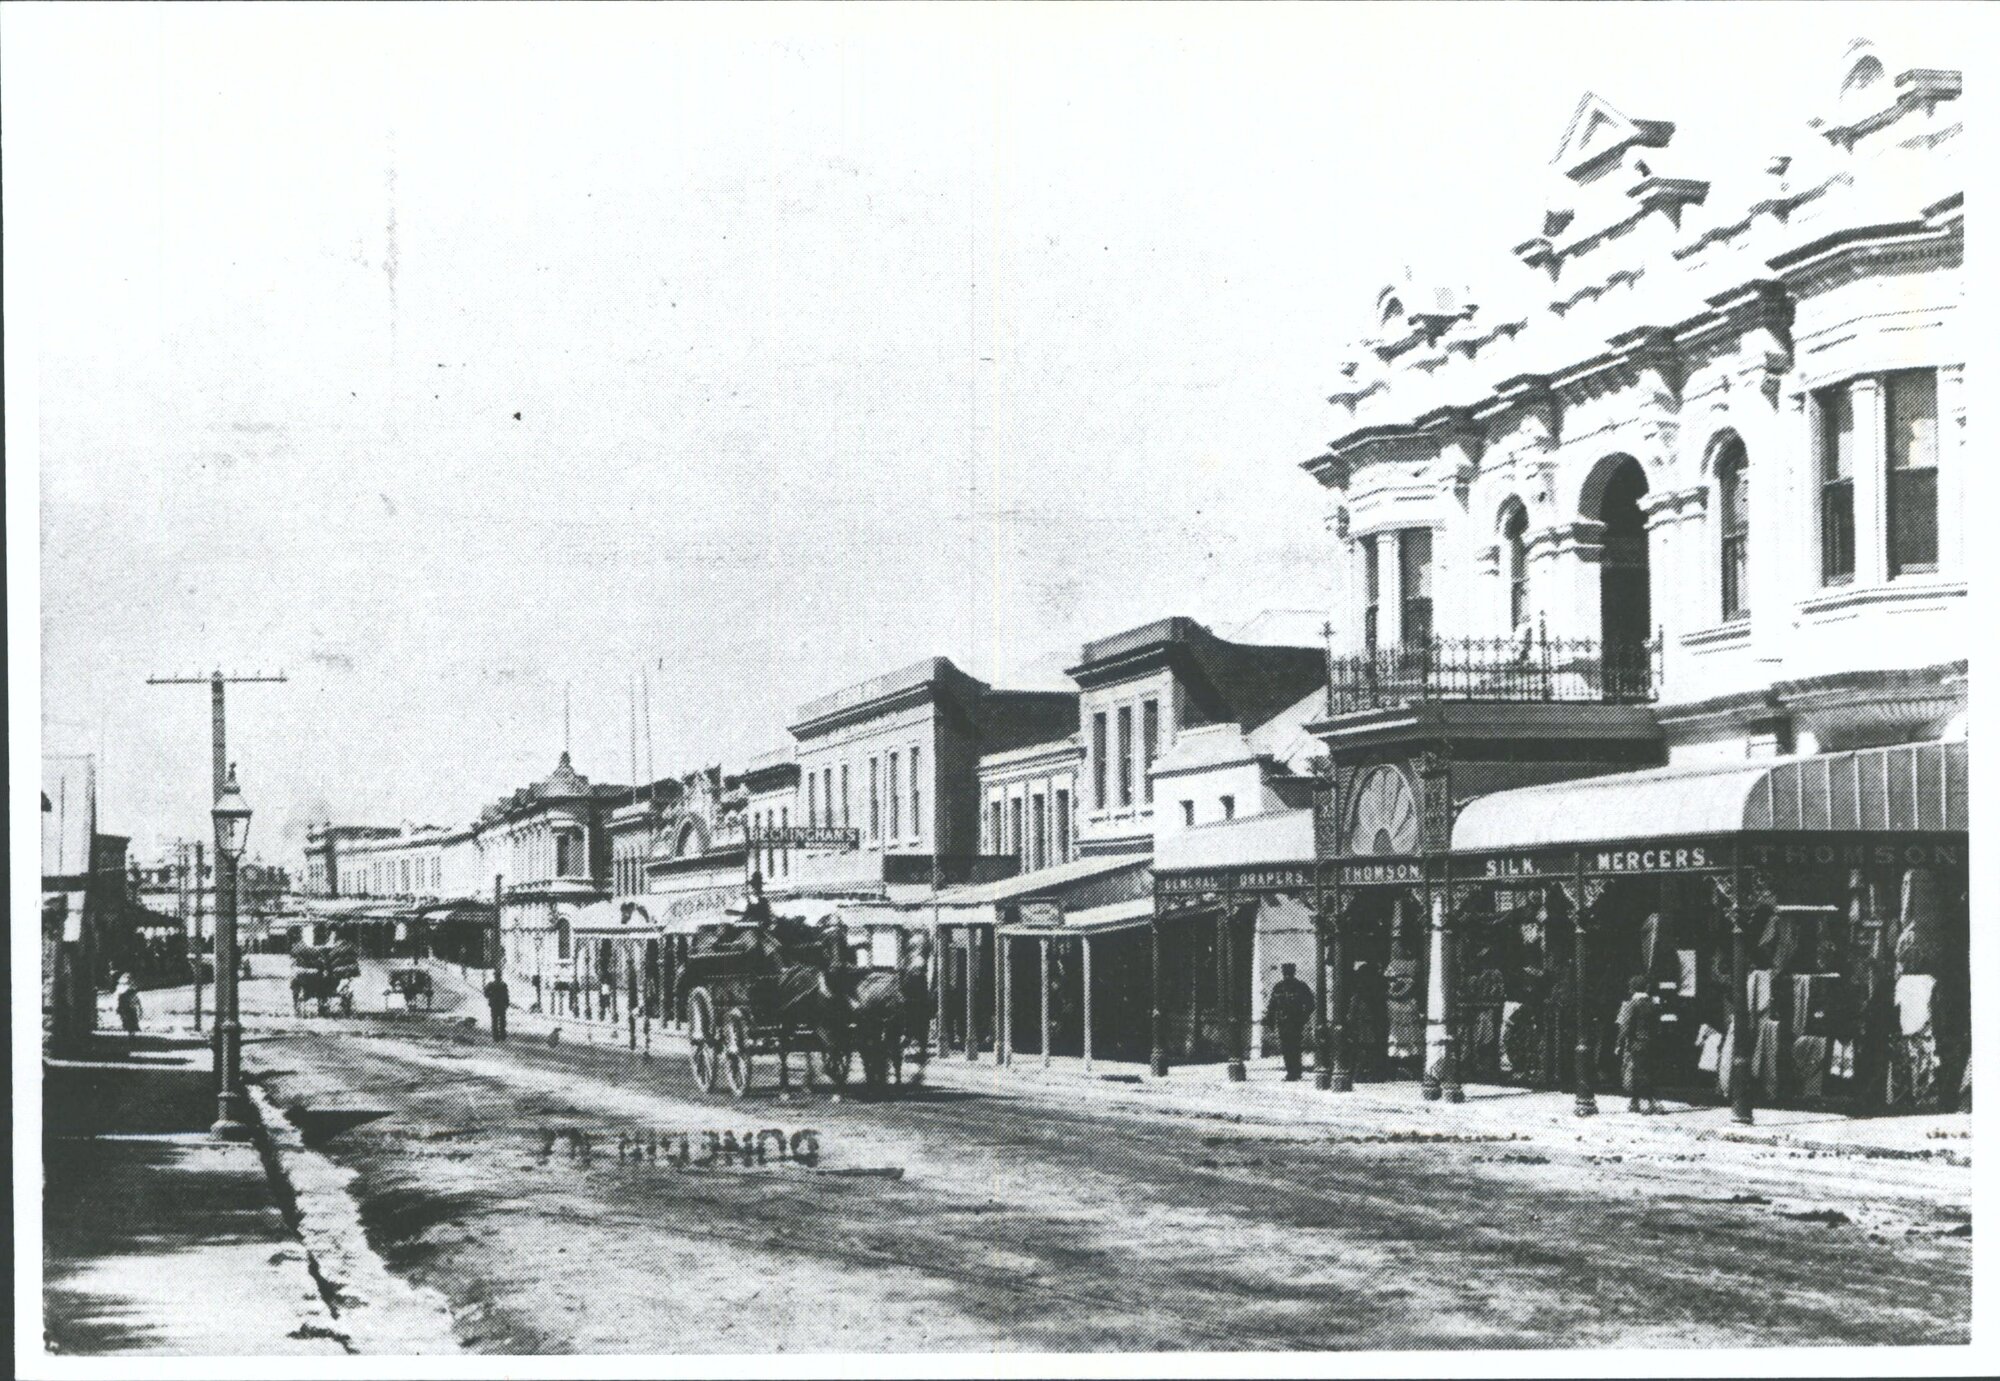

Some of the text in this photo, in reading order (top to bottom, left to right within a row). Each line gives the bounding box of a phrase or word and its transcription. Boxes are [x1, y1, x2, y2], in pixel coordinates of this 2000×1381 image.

[1595, 847, 1714, 871] MERCERS.
[1751, 844, 1958, 866] THOMSON
[1163, 875, 1219, 891] GENERAL
